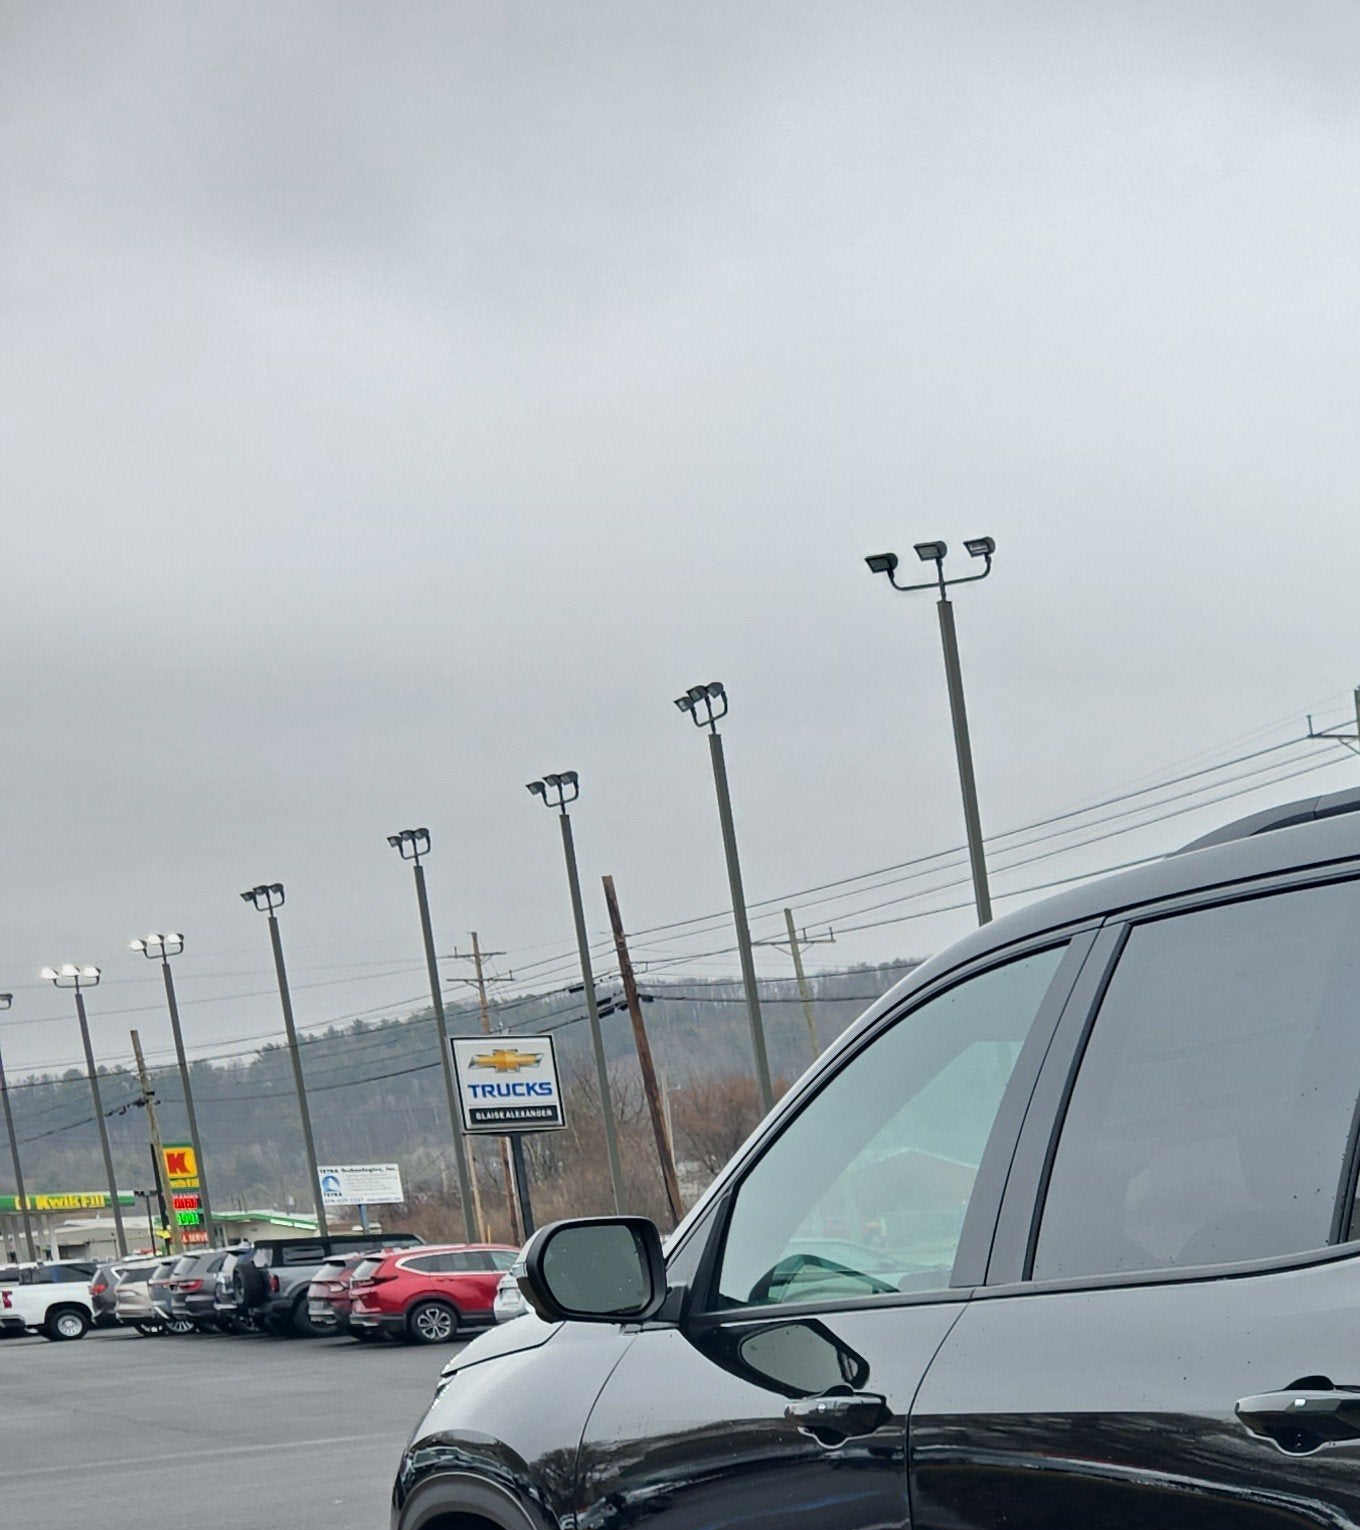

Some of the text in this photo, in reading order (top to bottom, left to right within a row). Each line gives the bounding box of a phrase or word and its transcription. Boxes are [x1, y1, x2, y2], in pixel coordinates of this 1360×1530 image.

[467, 1081, 553, 1099] TRUCKS
[165, 1152, 191, 1175] K
[36, 1194, 80, 1211] Kwik
